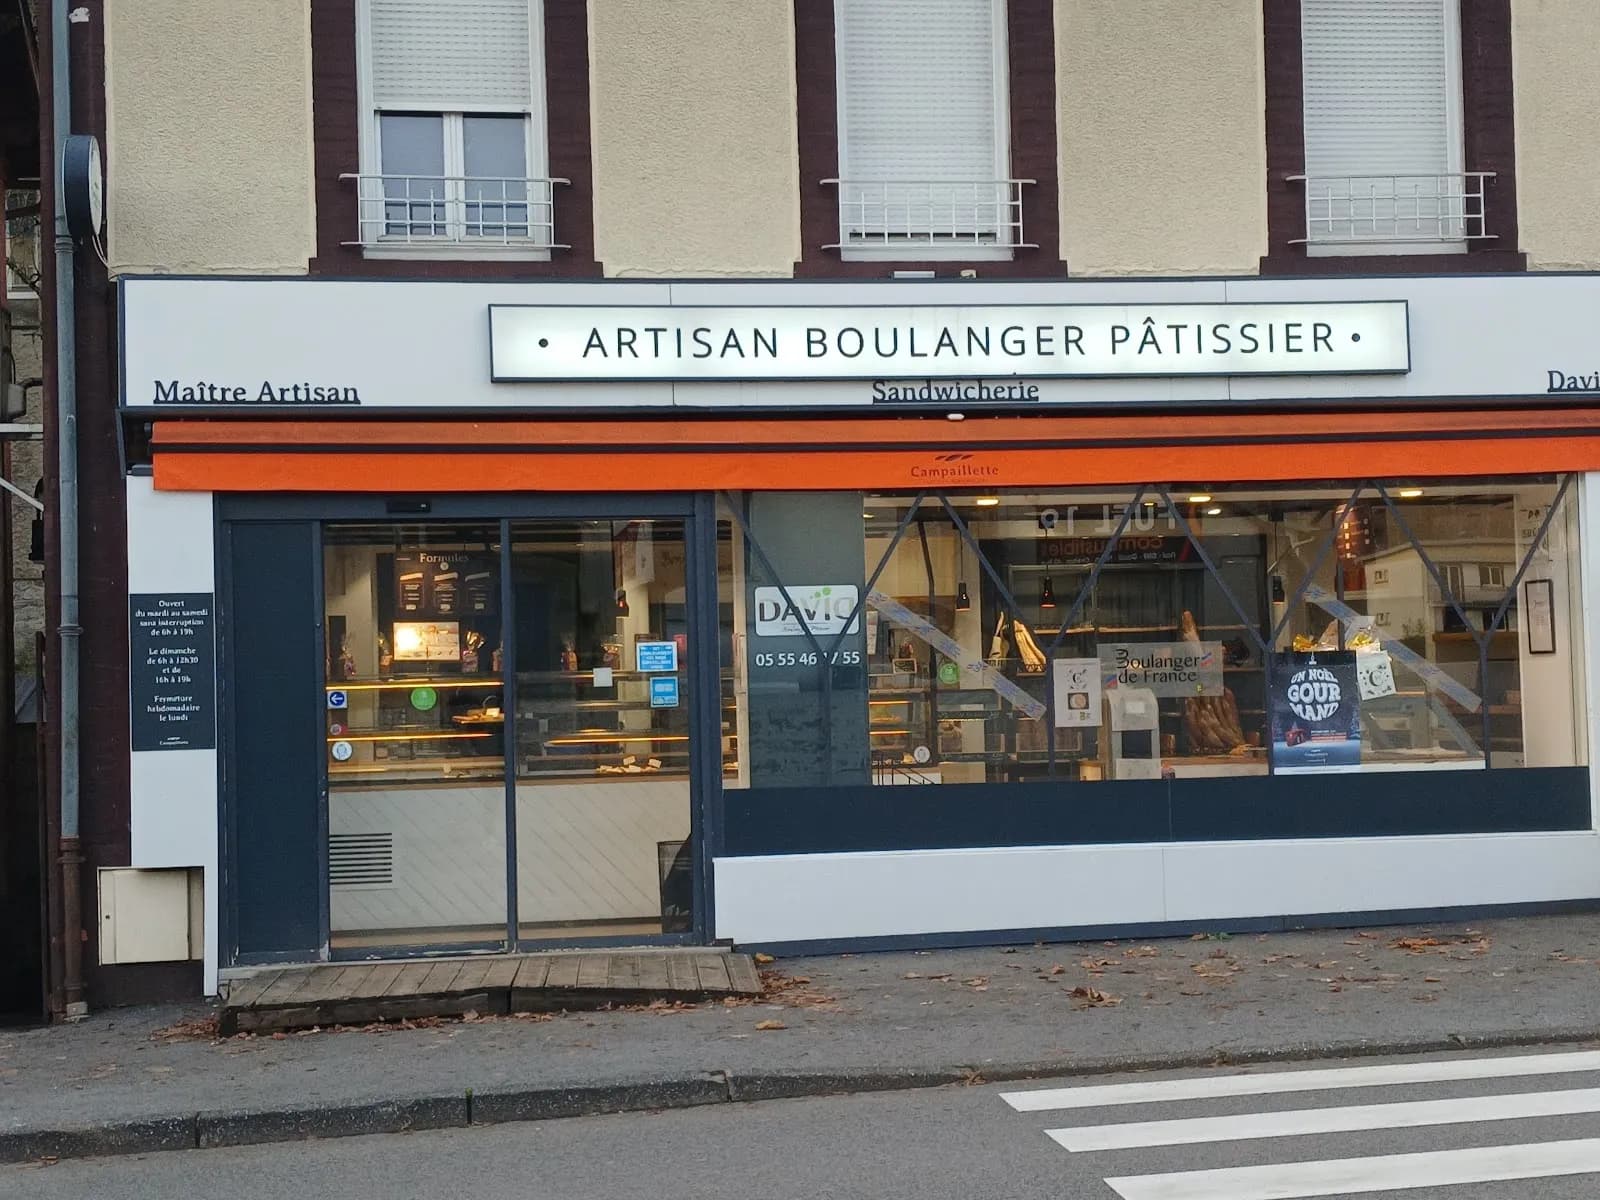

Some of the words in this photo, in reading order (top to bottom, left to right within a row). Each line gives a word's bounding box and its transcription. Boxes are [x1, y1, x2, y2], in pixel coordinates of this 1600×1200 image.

[583, 327, 778, 358] ARTISAN
[807, 325, 1085, 358] BOULANGER
[1111, 316, 1334, 355] PÂTISSIER
[154, 380, 247, 403] Maître
[258, 380, 359, 403] Artisan
[872, 379, 1039, 402] Sandwicherie
[910, 464, 1000, 478] Campaillette
[158, 600, 185, 608] Ouvert
[135, 608, 146, 618] du
[147, 608, 170, 618] mardi
[182, 608, 208, 617] samedi
[158, 617, 205, 628] interruption
[150, 628, 160, 636] de
[180, 628, 194, 636] 19h
[148, 647, 159, 656] Le
[160, 647, 196, 655] dimanche
[146, 656, 156, 665] de
[157, 656, 168, 665] 6h
[176, 656, 199, 665] 12h30
[755, 653, 774, 666] 05
[777, 652, 796, 666] 55
[798, 652, 818, 665] 46
[842, 651, 860, 665] 55
[1115, 648, 1200, 671] Boulanger
[162, 666, 170, 674] et
[172, 666, 181, 674] de
[155, 675, 169, 684] 16h
[177, 674, 192, 683] 19h
[1118, 671, 1138, 684] de
[1144, 670, 1198, 684] France
[1290, 670, 1307, 684] UN
[154, 694, 193, 703] Fermeture
[1287, 682, 1341, 704] GOUR
[147, 703, 201, 713] hebdomadaire
[1289, 702, 1339, 722] MAND
[159, 713, 167, 722] le
[168, 713, 189, 721] lundi
